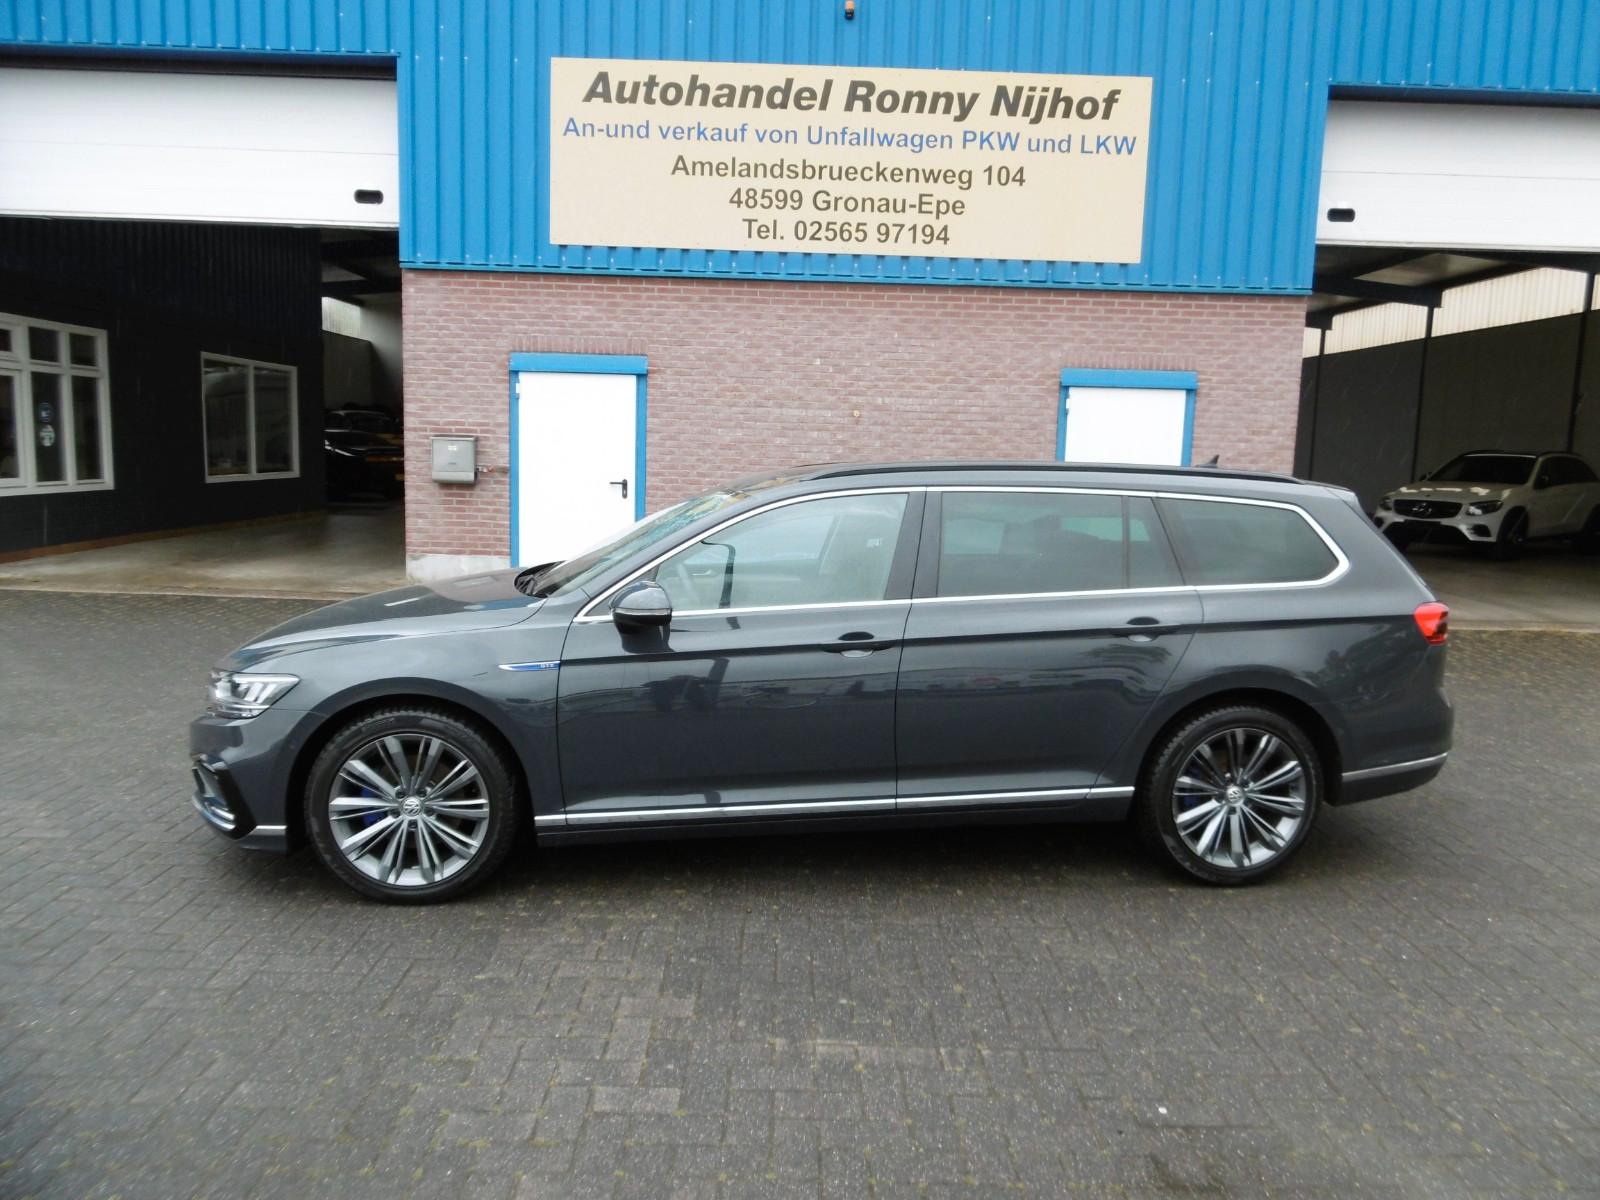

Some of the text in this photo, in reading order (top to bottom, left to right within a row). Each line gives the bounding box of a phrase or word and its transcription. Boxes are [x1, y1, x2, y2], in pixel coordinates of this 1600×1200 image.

[582, 71, 1122, 125] Autohandel Ronny Nijhof
[563, 117, 1137, 156] An-und verkauf von Unfallwagen PKW und LKW
[671, 154, 1026, 190] Amelandsbrueckenweg 104
[728, 187, 966, 220] 48599 Gronau-Epe
[742, 218, 950, 246] Tel. 02565 97194
